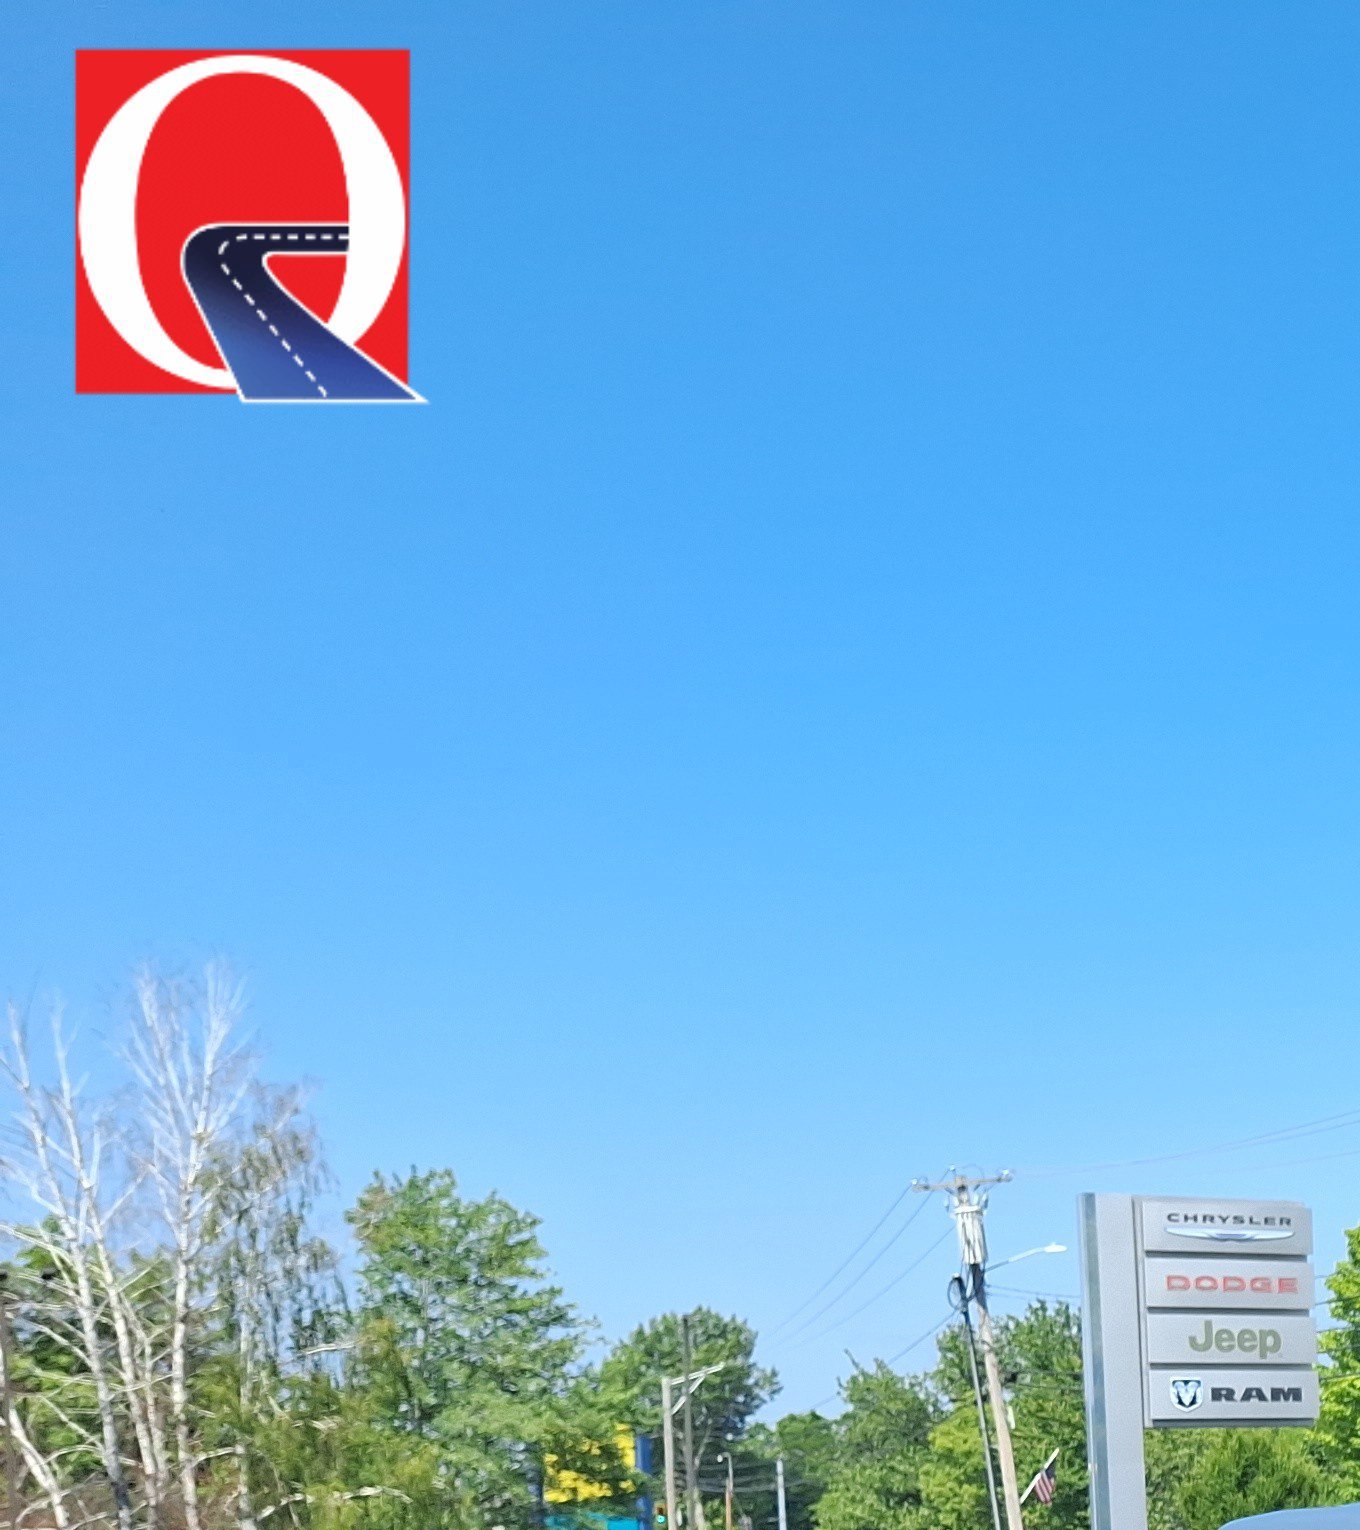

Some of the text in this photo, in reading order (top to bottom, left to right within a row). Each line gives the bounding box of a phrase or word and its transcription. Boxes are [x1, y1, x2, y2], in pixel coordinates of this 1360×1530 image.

[1166, 1212, 1294, 1227] CHRYSLER
[1166, 1275, 1298, 1294] DODGE
[1188, 1320, 1282, 1359] Jeep
[1210, 1386, 1303, 1402] RAM
